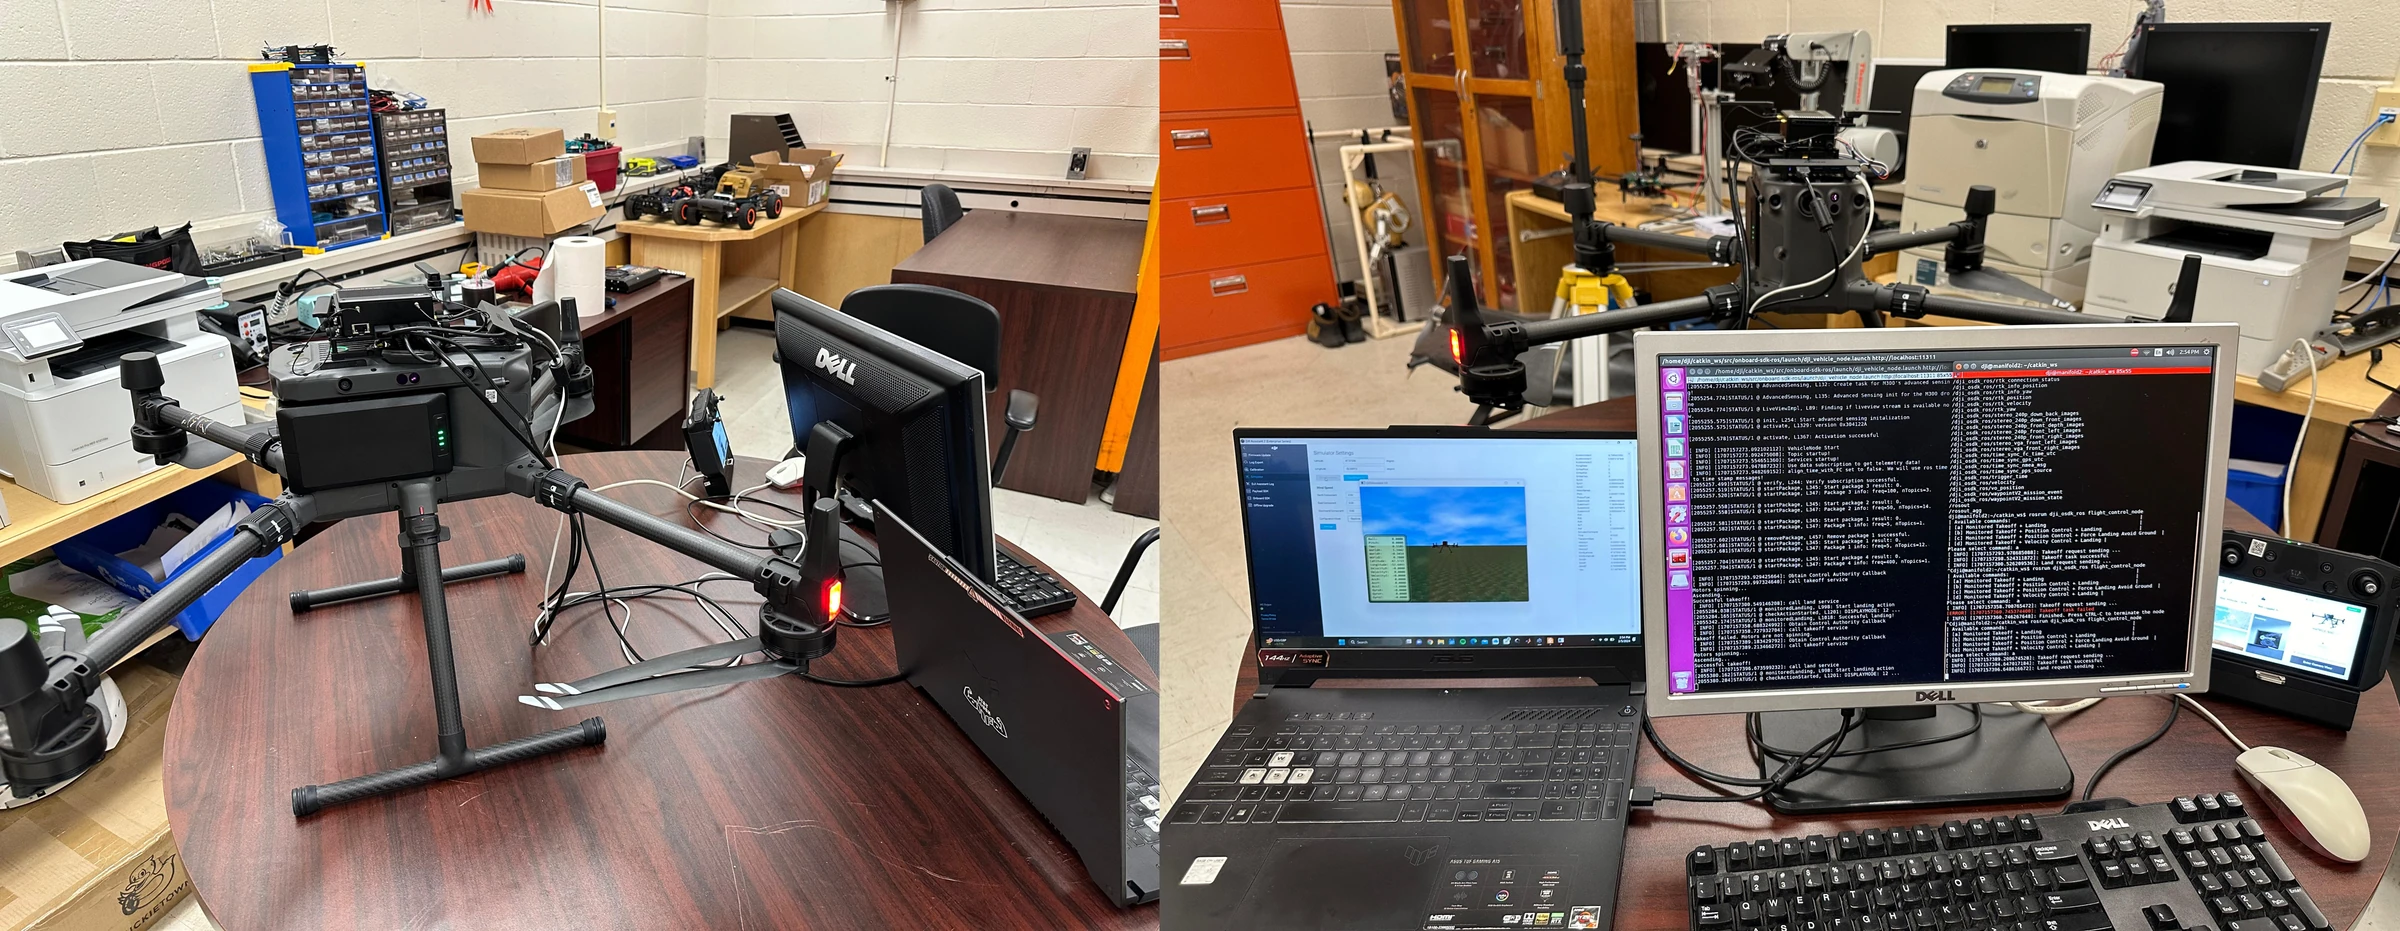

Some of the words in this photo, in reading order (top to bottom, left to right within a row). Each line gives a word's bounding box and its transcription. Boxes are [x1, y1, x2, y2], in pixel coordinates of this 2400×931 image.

[815, 347, 857, 386] DELL
[1915, 690, 1956, 702] DELL
[2087, 817, 2129, 831] DELL
[1954, 878, 1963, 887] O
[1797, 896, 1803, 904] E
[1823, 893, 1830, 901] R
[129, 880, 189, 931] CKIETOW
[1742, 902, 1750, 910] Q
[1768, 899, 1778, 907] W
[1968, 903, 1976, 911] L
[1889, 912, 1897, 920] H
[1917, 909, 1922, 917] J
[1835, 918, 1841, 926] F
[1862, 915, 1871, 923] G
[1807, 921, 1815, 929] D
